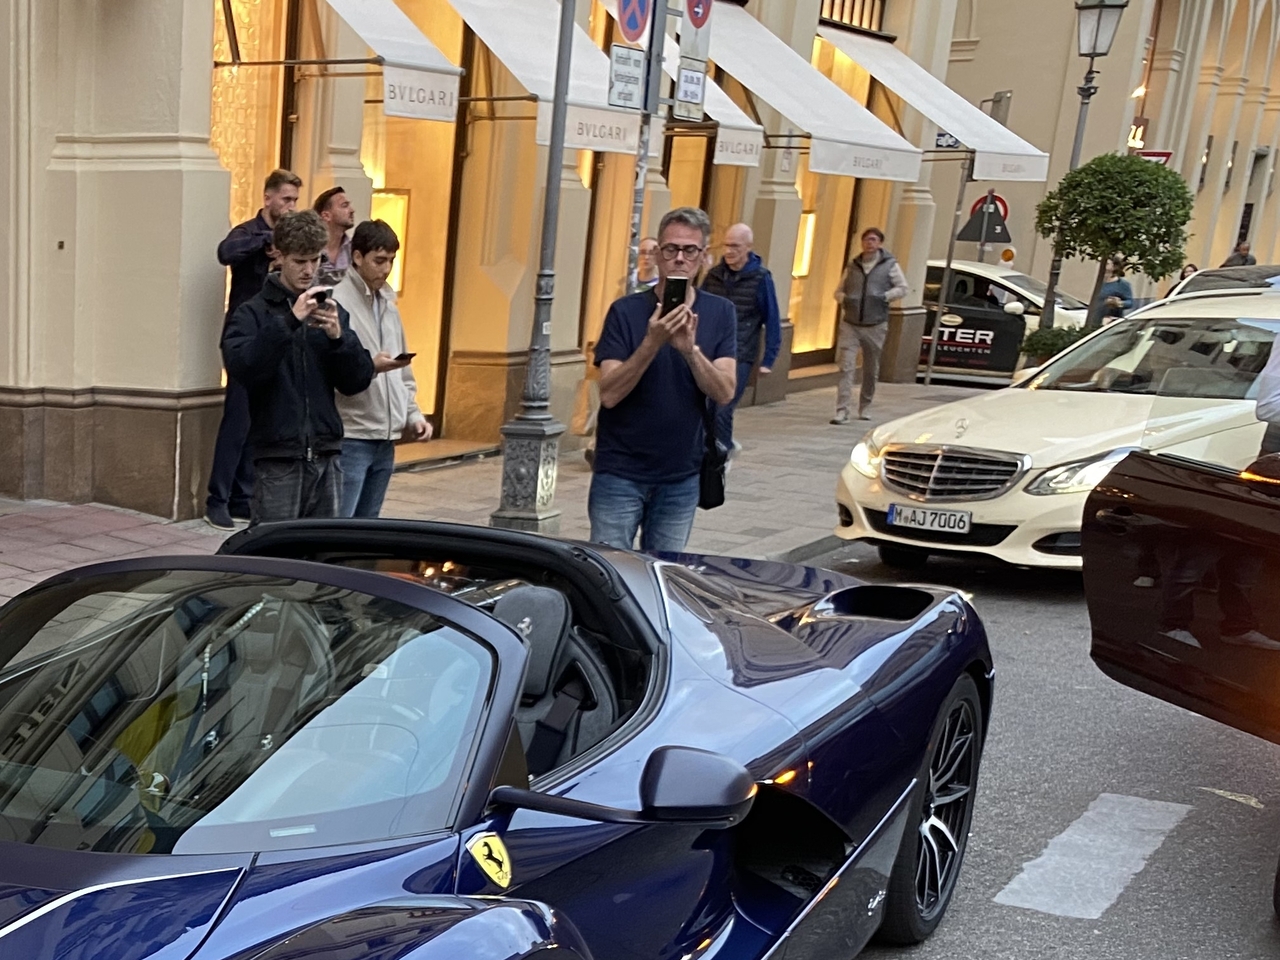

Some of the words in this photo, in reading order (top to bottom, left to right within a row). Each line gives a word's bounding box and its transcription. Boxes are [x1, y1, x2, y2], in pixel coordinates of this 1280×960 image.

[388, 84, 454, 107] BVLGARI
[576, 121, 627, 142] BVLGARI
[719, 140, 759, 156] BVLGARI
[922, 327, 994, 344] TER
[937, 344, 991, 354] LEUCHTEN
[929, 511, 966, 530] 7006
